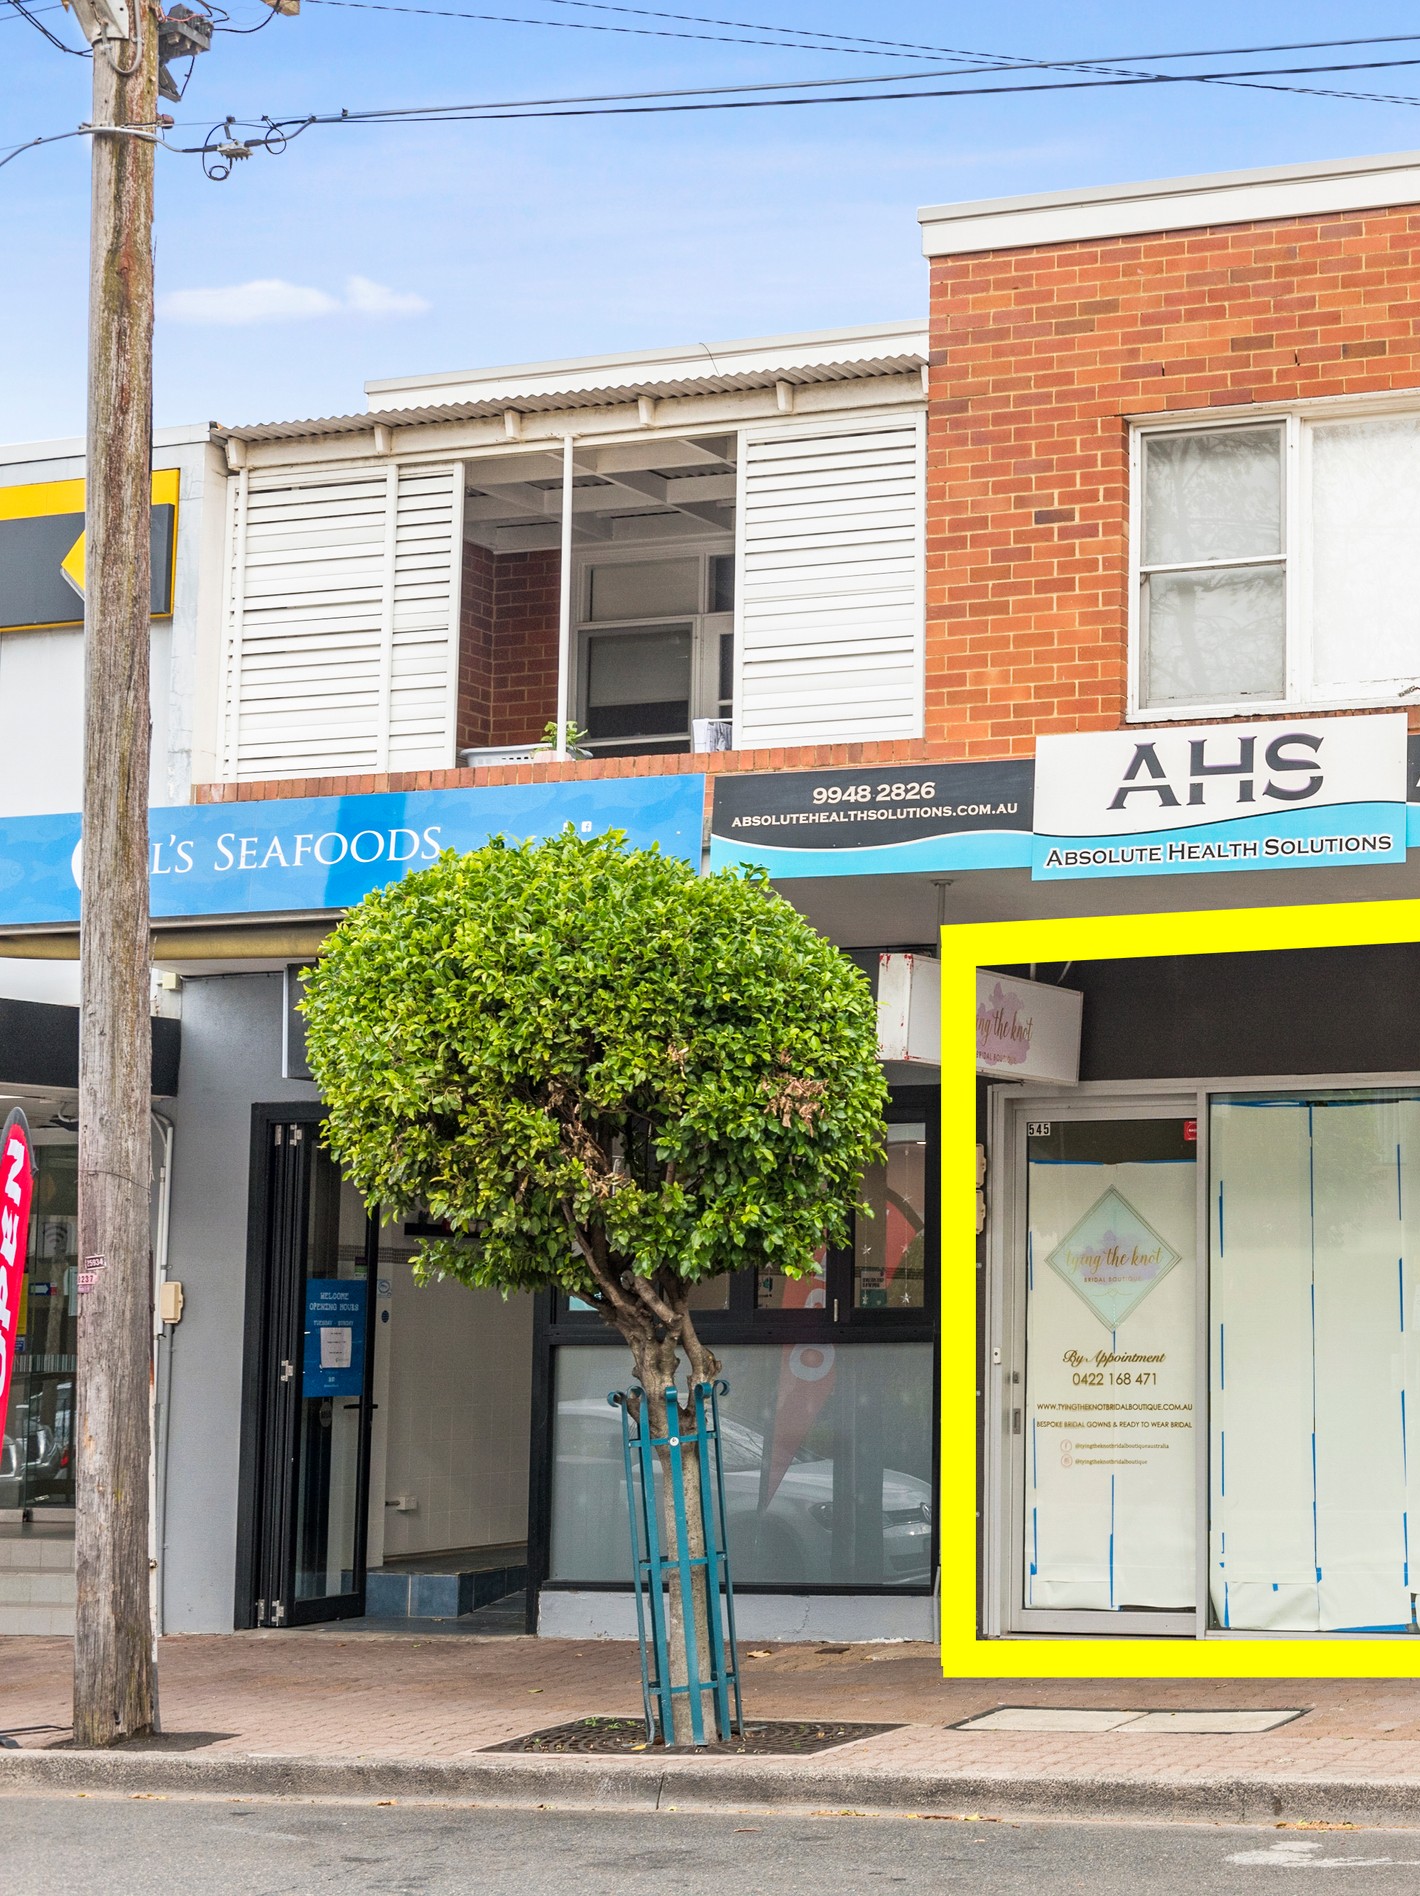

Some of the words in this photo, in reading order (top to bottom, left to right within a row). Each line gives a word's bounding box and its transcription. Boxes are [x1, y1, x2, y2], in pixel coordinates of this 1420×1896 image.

[1106, 732, 1325, 810] AHS
[812, 785, 872, 804] 9948
[876, 781, 936, 802] 2826
[731, 802, 1018, 828] ABSOLUTEHEALTHSOLUTIONS.COM.AU
[214, 826, 442, 872] SEAFOODS
[1046, 846, 1161, 867] ABSOLUTE
[1168, 842, 1257, 861] HEALTH
[1264, 834, 1393, 856] SOLUTIONS
[992, 1007, 1011, 1040] the
[1010, 1010, 1034, 1042] knot
[1028, 1123, 1050, 1135] 545
[1065, 1248, 1102, 1275] tying
[1103, 1245, 1129, 1268] the
[1130, 1245, 1163, 1267] knot
[1108, 1275, 1144, 1283] BOUTIQUE
[320, 1292, 350, 1300] WELCOME
[309, 1302, 338, 1311] OPENING
[339, 1303, 359, 1311] HOURS
[1062, 1349, 1084, 1368] By
[1085, 1349, 1166, 1367] Appointment
[1072, 1372, 1104, 1386] 0422
[1109, 1372, 1132, 1386] 168
[1135, 1372, 1158, 1386] 471
[1036, 1403, 1193, 1412] WWW.TYINGTHEKNOTBRIDALBOUTIQUE.COM.AU
[1036, 1421, 1063, 1429] BESPOKE
[1064, 1421, 1085, 1429] BRIDAL
[1086, 1421, 1112, 1429] GOWNS
[1112, 1421, 1118, 1429] &
[1119, 1421, 1139, 1429] READY
[1141, 1421, 1150, 1429] TO
[1151, 1421, 1169, 1429] WEAR
[1170, 1421, 1193, 1429] BRIDAL
